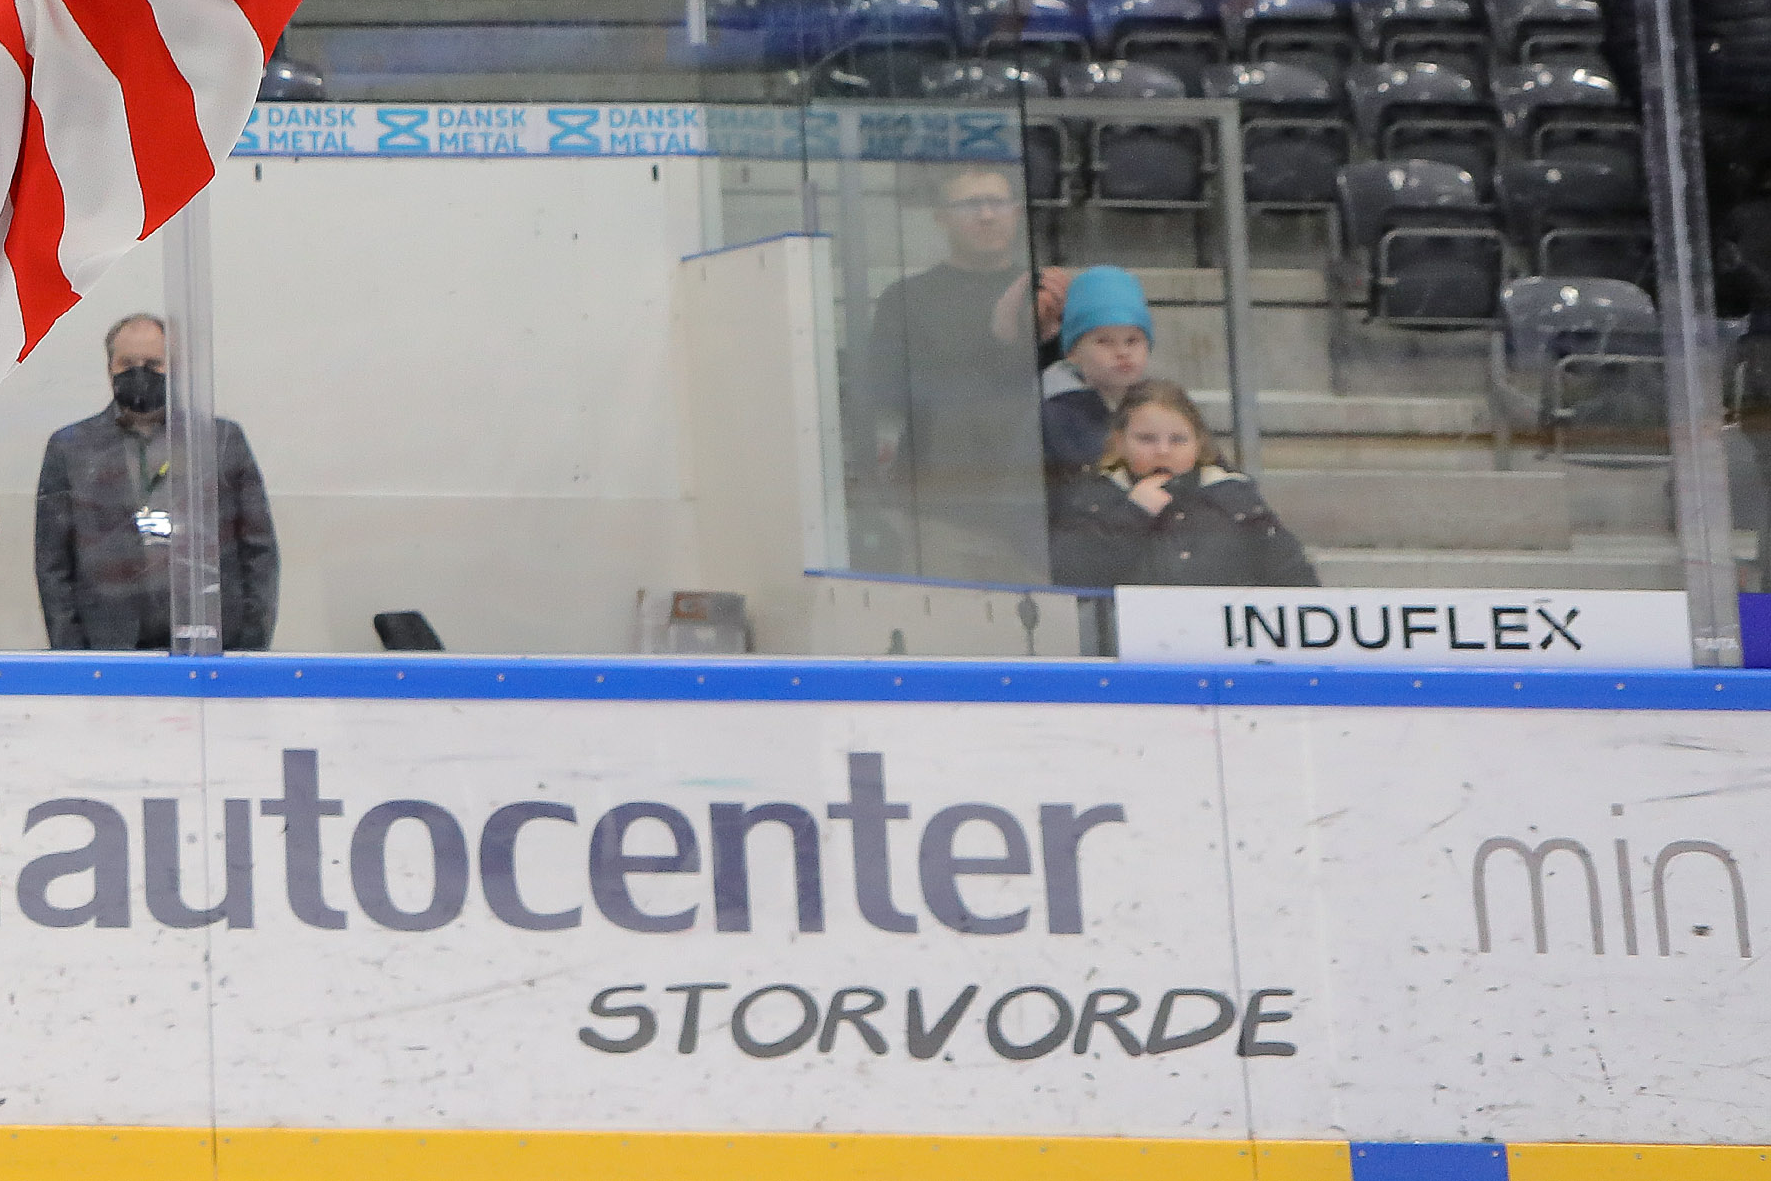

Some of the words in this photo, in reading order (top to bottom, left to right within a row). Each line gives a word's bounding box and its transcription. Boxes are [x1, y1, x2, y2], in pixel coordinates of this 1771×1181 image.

[268, 107, 357, 127] DANSK
[438, 108, 527, 127] DANSK
[609, 108, 700, 128] DANSK
[268, 131, 355, 152] METAL
[438, 132, 527, 153] METAL
[609, 131, 695, 152] METAL
[1223, 604, 1583, 651] INDUFLEX
[16, 748, 1126, 935] autocenter
[1472, 802, 1753, 959] min
[579, 982, 1296, 1060] STORVORDE
